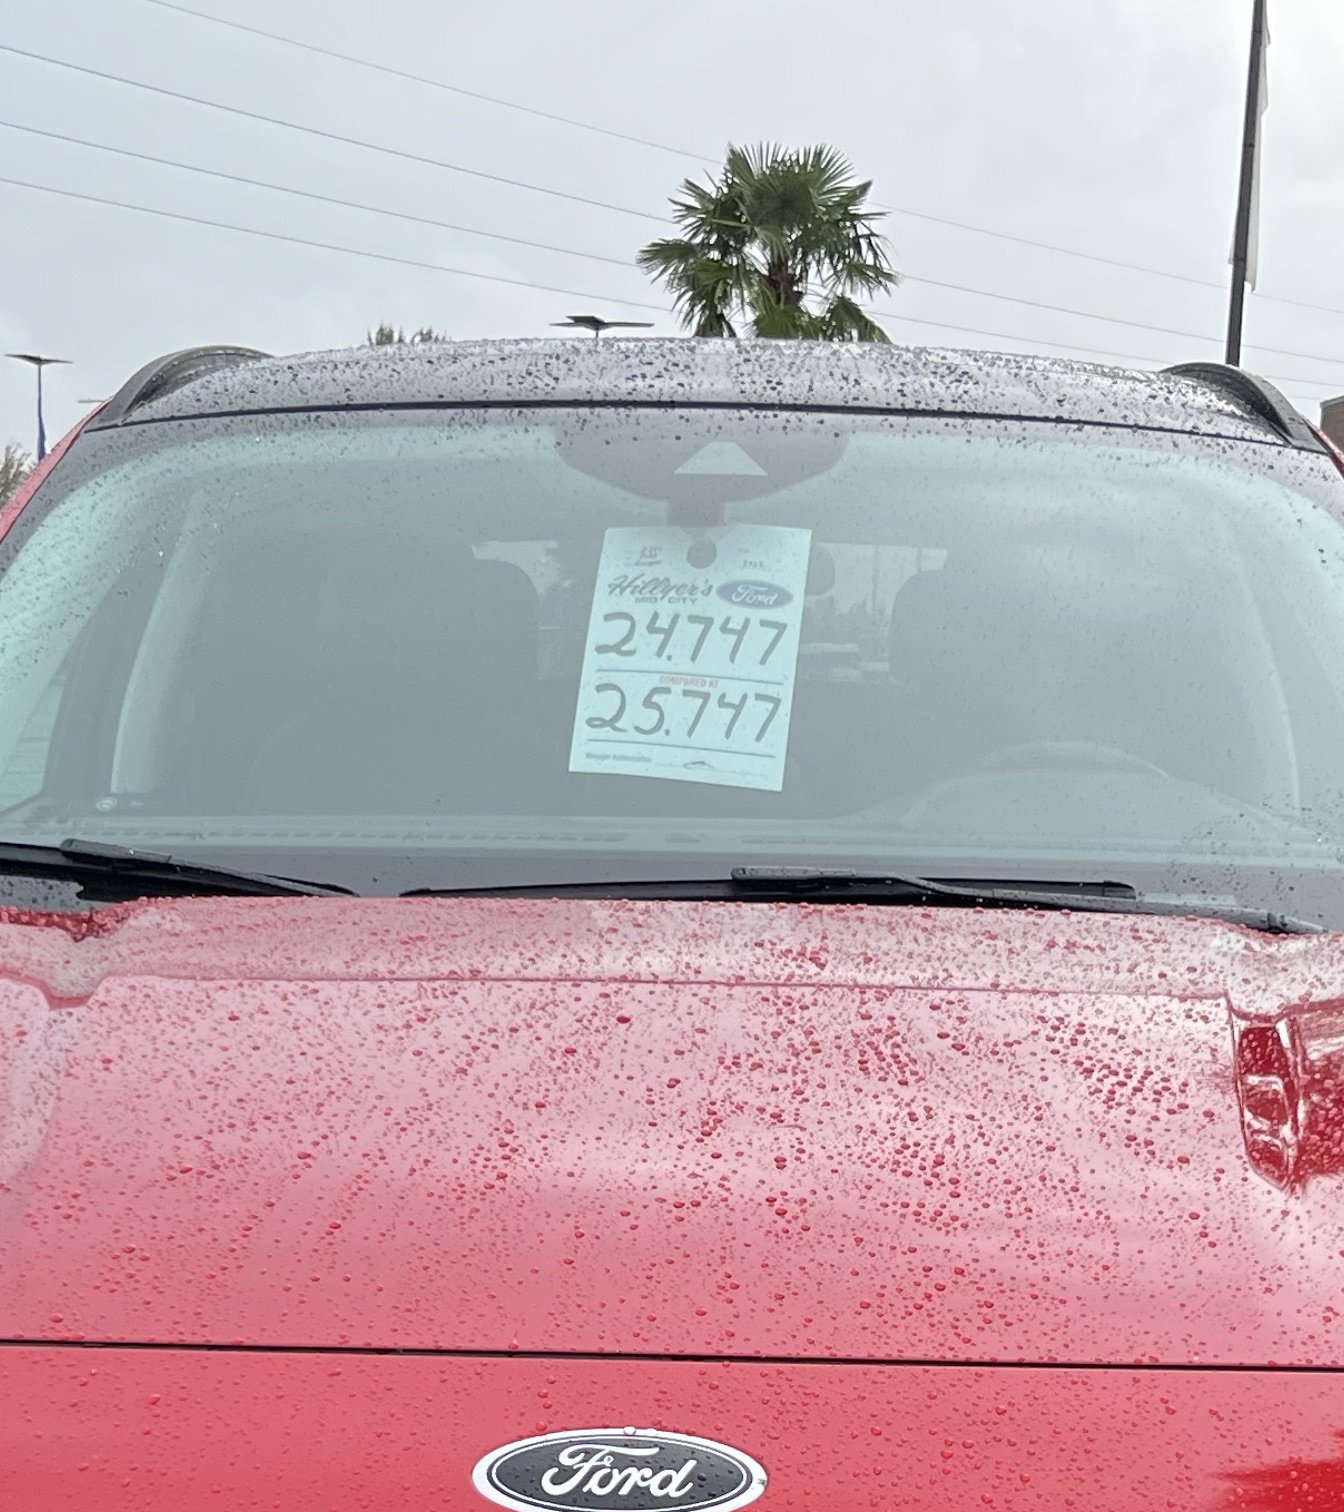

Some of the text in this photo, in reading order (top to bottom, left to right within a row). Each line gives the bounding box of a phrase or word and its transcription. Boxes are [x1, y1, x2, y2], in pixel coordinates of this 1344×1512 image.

[608, 573, 778, 605] Hillyer's Ford
[635, 596, 698, 605] MID CITY
[659, 675, 719, 689] COMPARED AT
[541, 1443, 697, 1498] Ford
